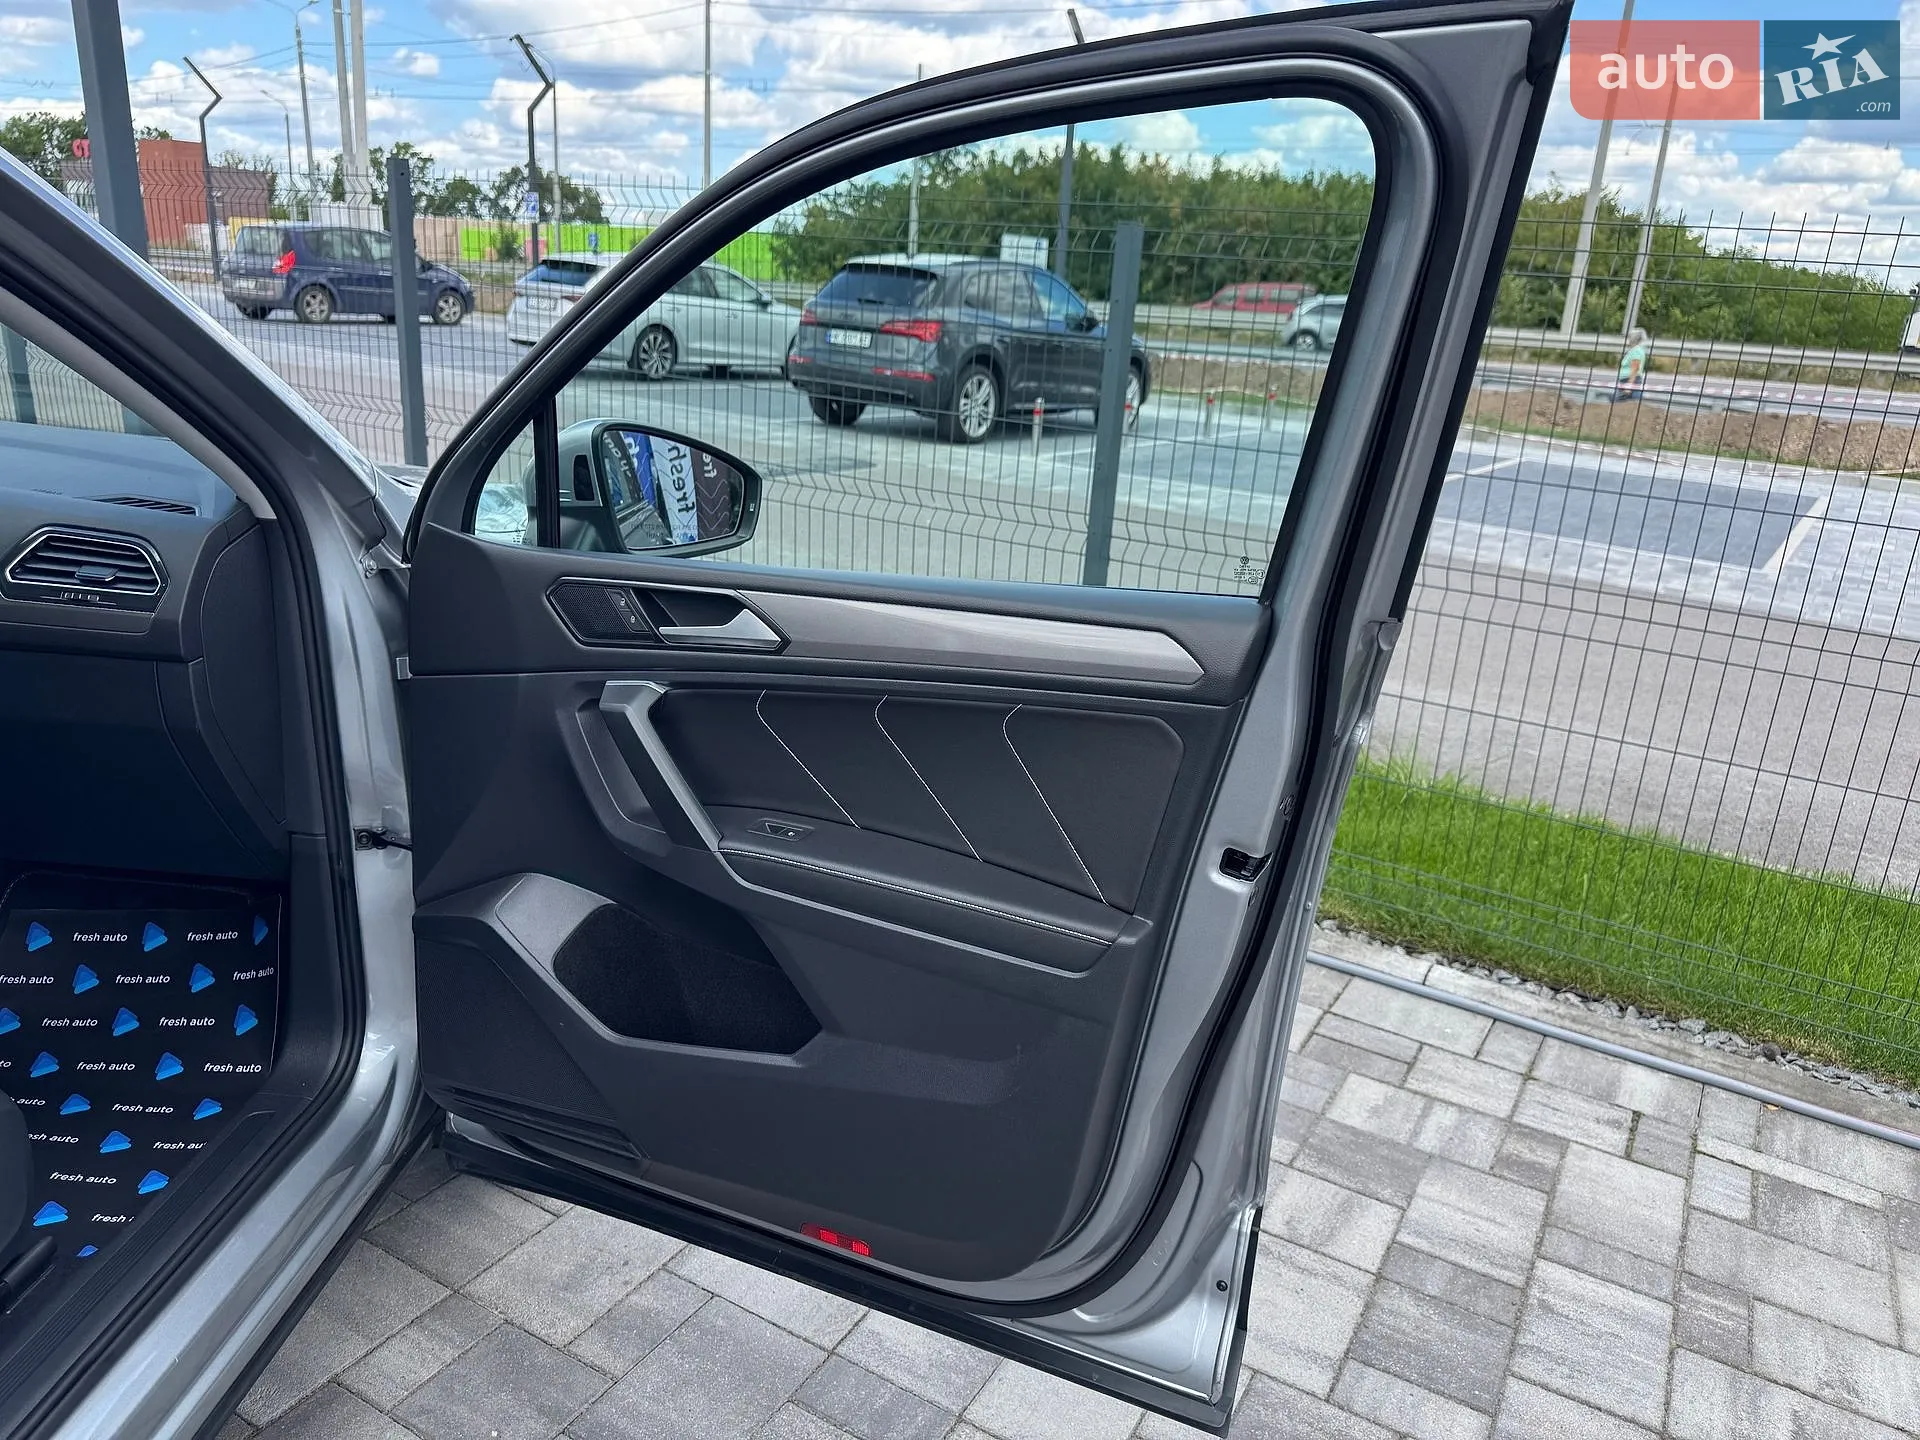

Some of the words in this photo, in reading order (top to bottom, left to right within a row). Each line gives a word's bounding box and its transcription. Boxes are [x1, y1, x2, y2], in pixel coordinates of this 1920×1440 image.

[73, 932, 101, 942] fresh
[102, 933, 128, 942] auto
[187, 931, 214, 942] fresh
[215, 930, 239, 941] auto
[0, 974, 27, 984] fresh
[28, 975, 54, 984] auto
[115, 974, 143, 984] fresh
[145, 974, 171, 984] auto
[233, 969, 256, 981] fresh
[257, 967, 274, 978] auto
[41, 1017, 70, 1027] fresh
[71, 1018, 98, 1027] auto
[158, 1016, 188, 1027] fresh
[189, 1017, 216, 1026] auto
[76, 1061, 107, 1071] fresh
[108, 1062, 136, 1071] auto
[203, 1062, 234, 1073] fresh
[235, 1063, 262, 1073] auto
[16, 1098, 46, 1106] auto
[111, 1103, 144, 1112] fresh
[144, 1105, 174, 1114] auto
[48, 1135, 80, 1144] auto
[152, 1141, 185, 1150] fresh
[49, 1171, 84, 1182] fresh
[85, 1176, 117, 1185] auto
[91, 1213, 127, 1223] fresh
